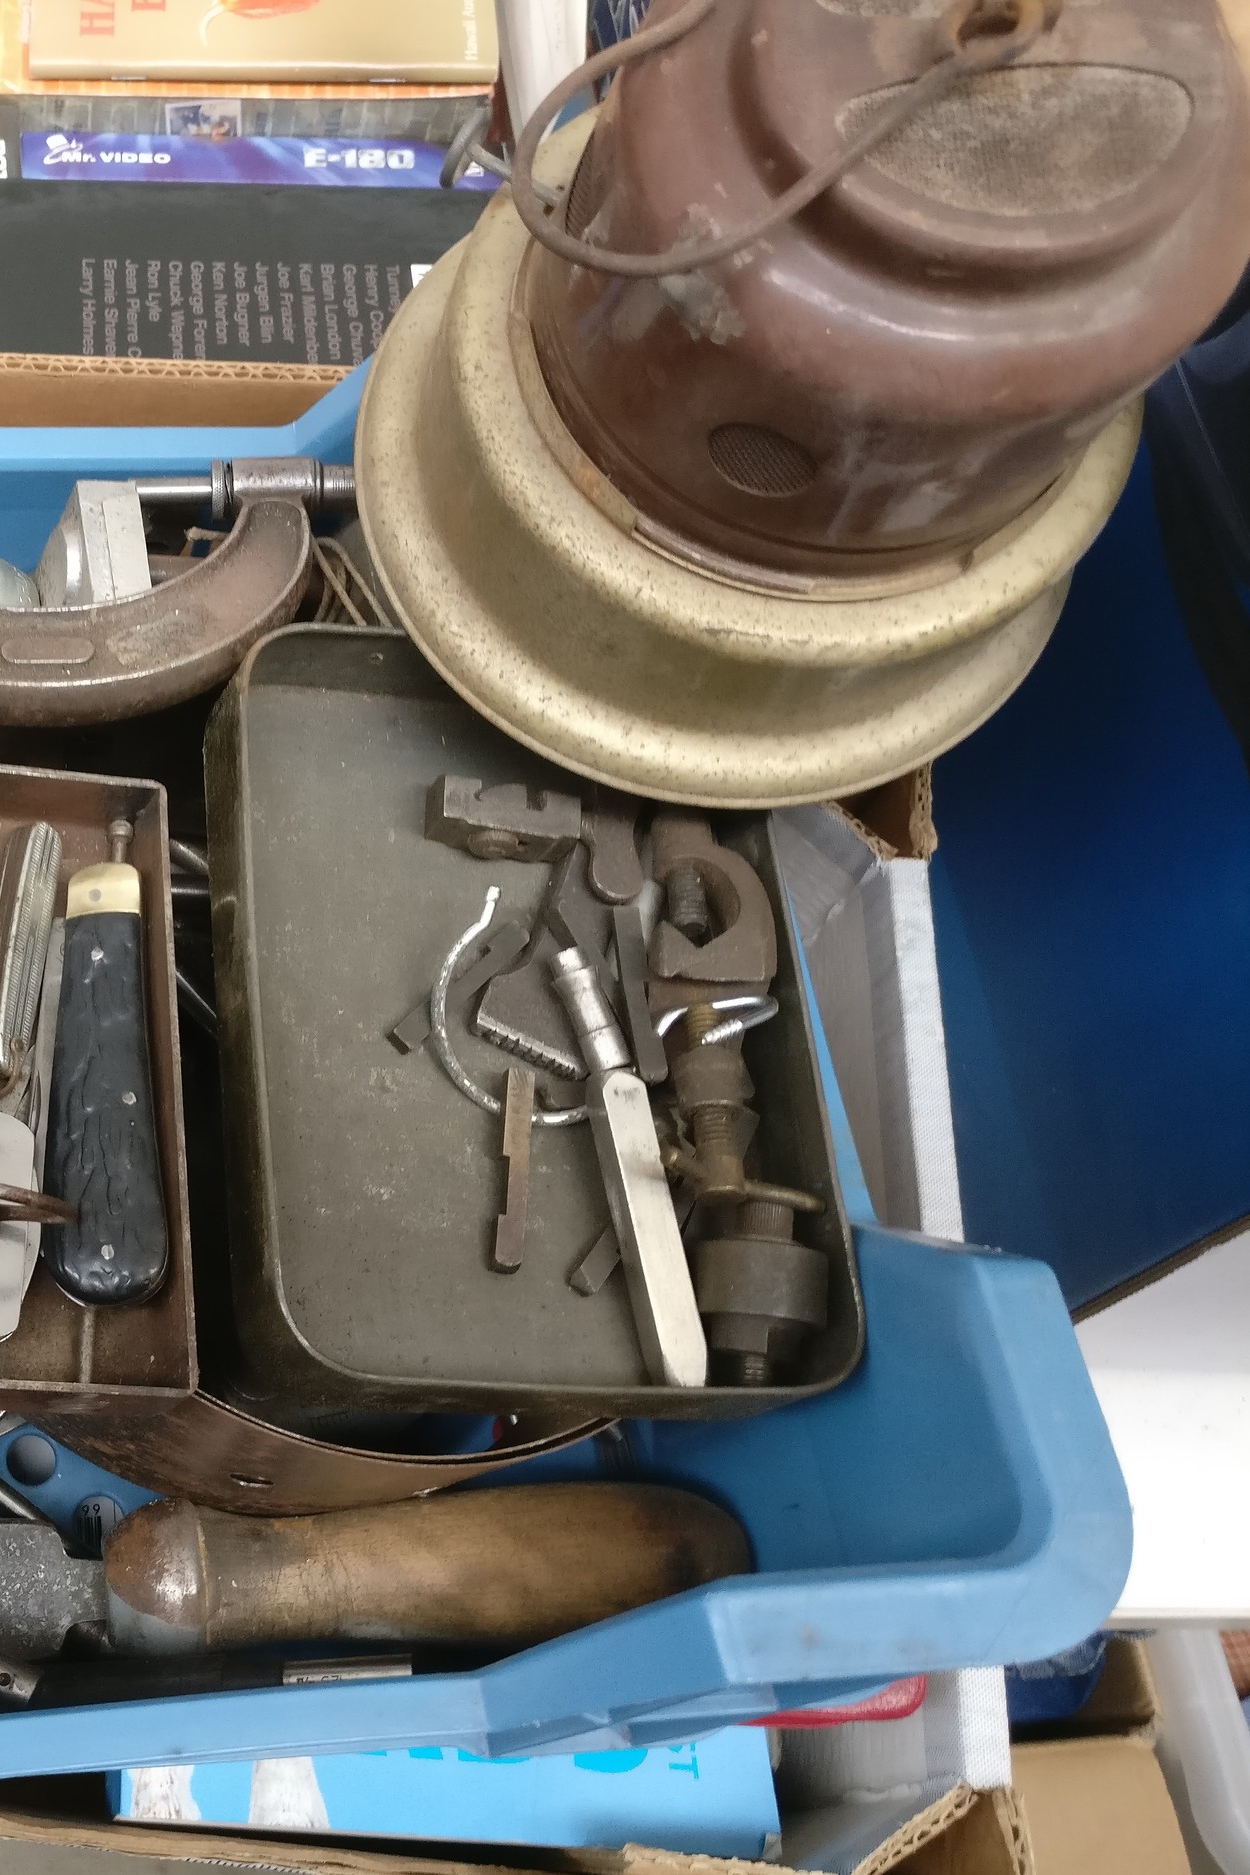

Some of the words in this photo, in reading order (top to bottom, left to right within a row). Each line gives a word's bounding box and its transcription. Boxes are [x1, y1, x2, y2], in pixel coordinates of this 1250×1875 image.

[61, 151, 96, 163] Mr.
[100, 152, 171, 164] VIDEO
[304, 148, 415, 169] E-180
[79, 258, 96, 296] Larry
[103, 258, 118, 304] Earnie
[125, 258, 139, 294] Jean
[147, 260, 161, 289] Ron
[169, 261, 184, 307] Chuck
[189, 261, 204, 314] George
[212, 262, 226, 290] Ken
[233, 261, 248, 289] Joe
[277, 261, 291, 289] Joe
[299, 263, 315, 293] Karl
[320, 263, 336, 301] Brian
[342, 264, 359, 318] George
[364, 264, 379, 307] Henry
[82, 299, 97, 355] Holmes
[126, 298, 141, 343] Pierre
[146, 293, 162, 321] Lyle
[214, 294, 228, 345] Norton
[234, 292, 250, 346] Bugner
[280, 293, 296, 344] Frazier
[259, 315, 275, 344] Blin
[302, 295, 320, 364] Mildenbe
[325, 304, 342, 360] London
